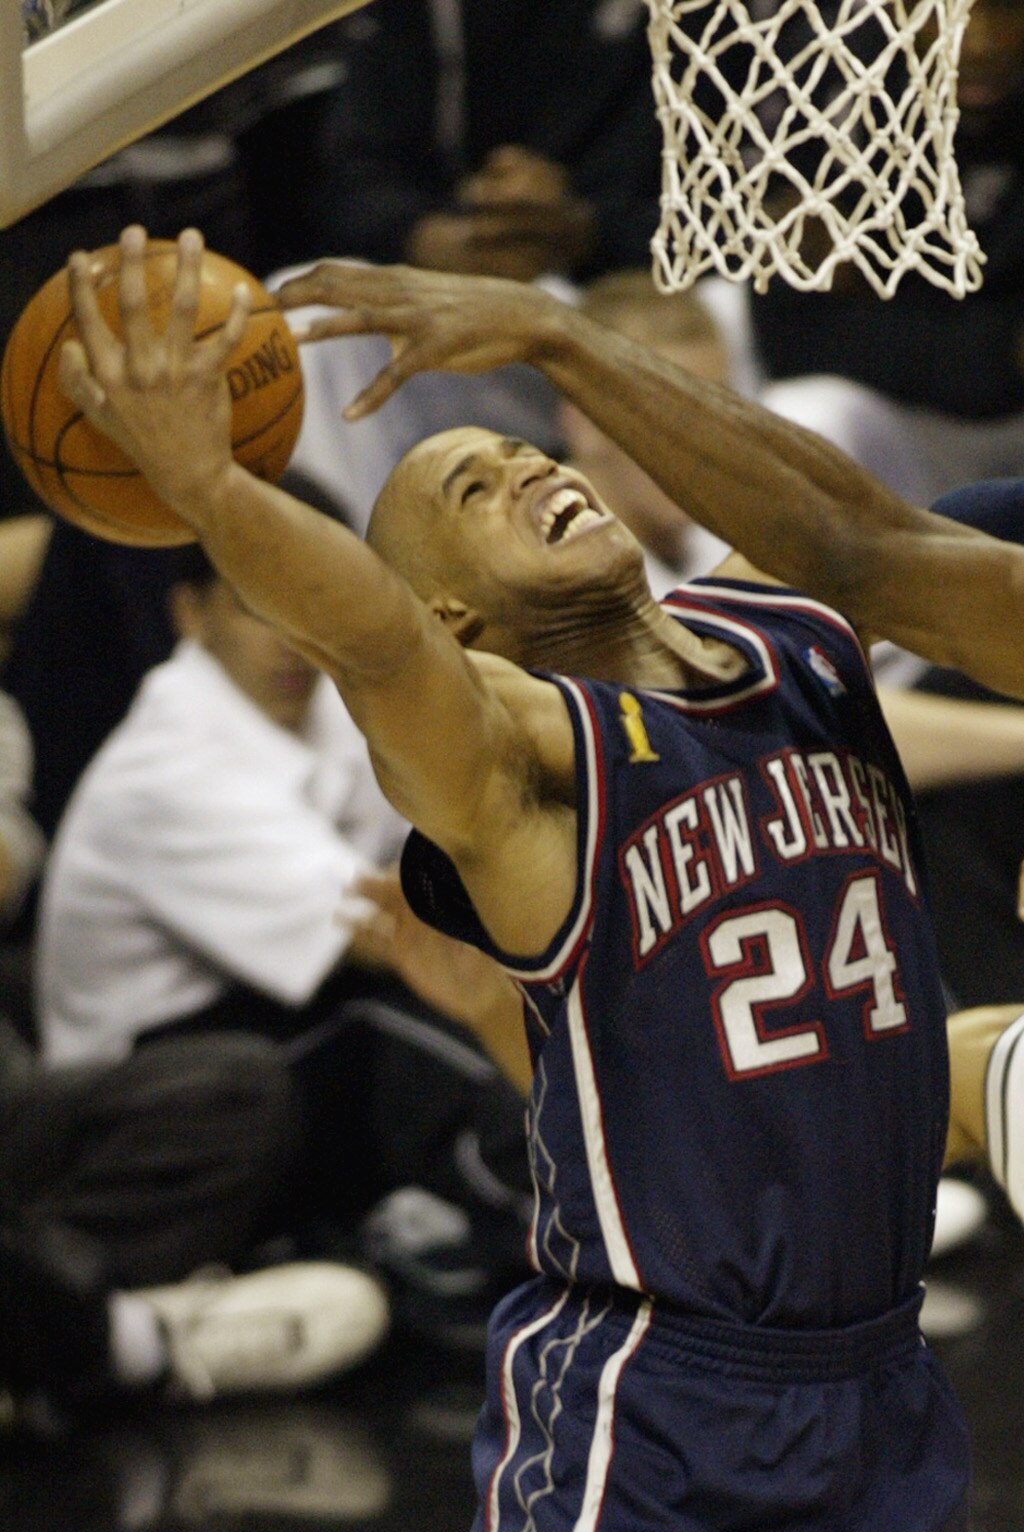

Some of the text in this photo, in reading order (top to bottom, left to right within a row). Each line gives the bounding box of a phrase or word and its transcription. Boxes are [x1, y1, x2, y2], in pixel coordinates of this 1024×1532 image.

[227, 329, 294, 401] DING
[621, 750, 917, 966] NEW JERSEY
[704, 869, 905, 1079] 24
